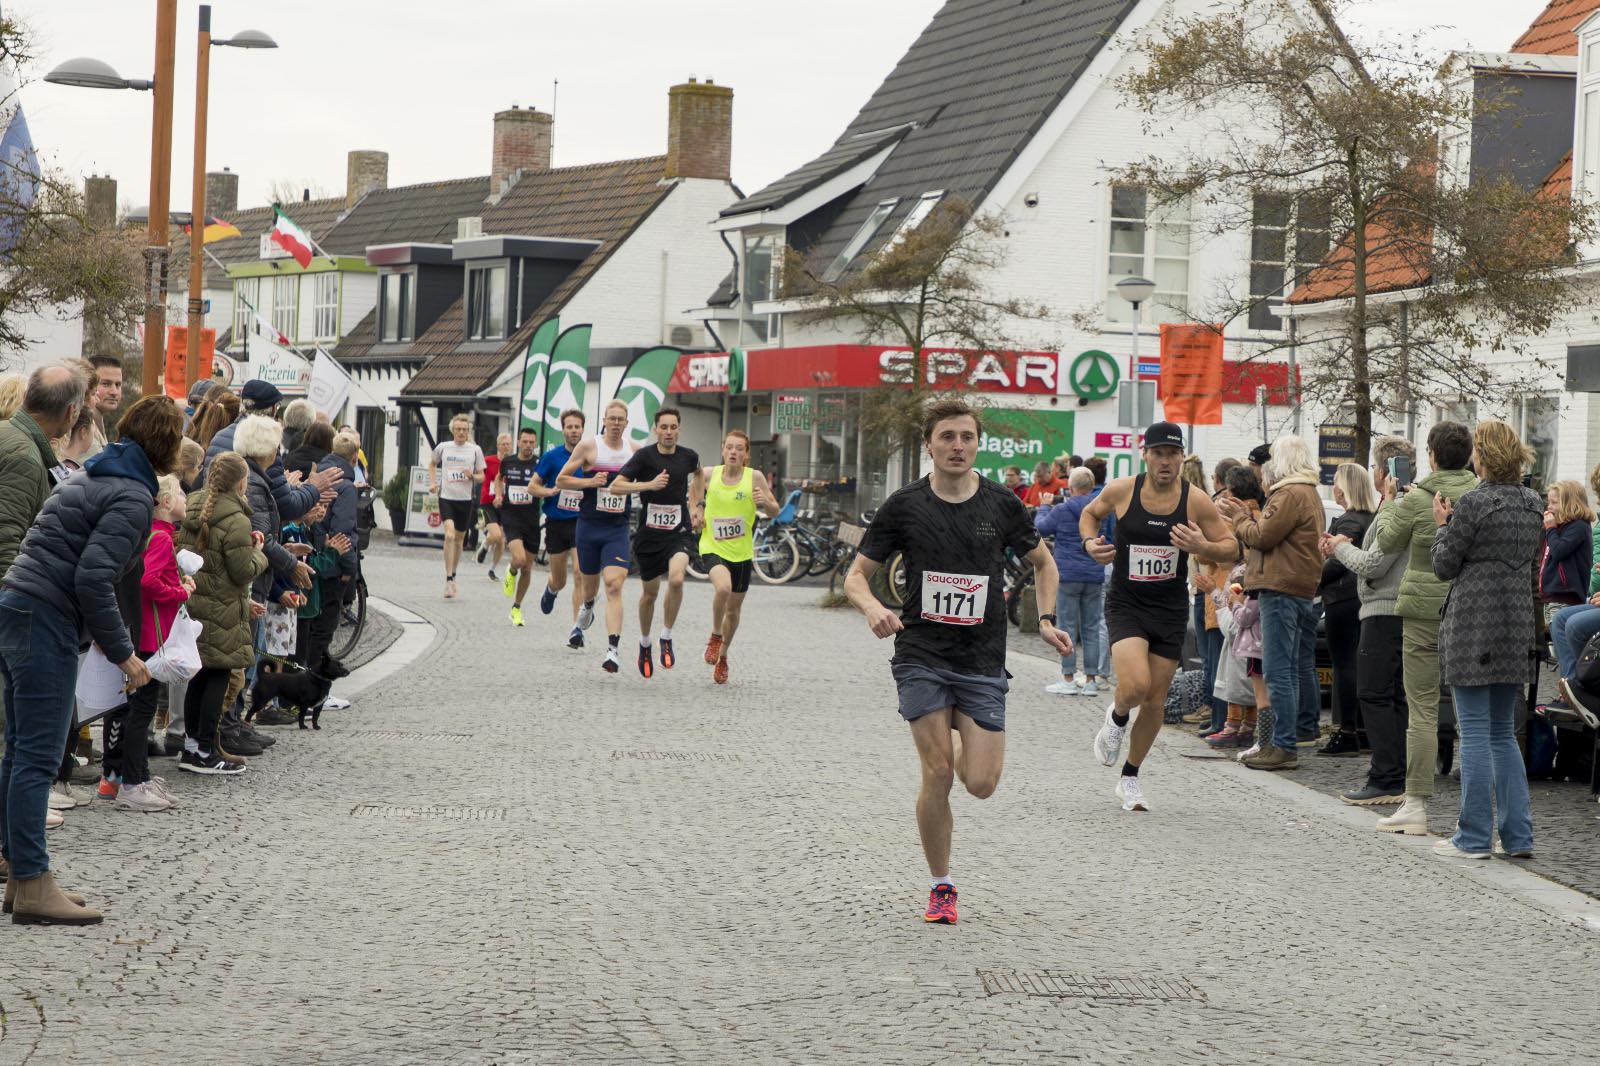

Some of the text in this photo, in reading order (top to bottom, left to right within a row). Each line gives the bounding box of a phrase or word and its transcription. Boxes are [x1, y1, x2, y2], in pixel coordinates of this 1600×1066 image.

[258, 364, 297, 381] Pizzeria
[689, 356, 729, 389] SPAR
[879, 350, 1056, 389] SPAR
[512, 493, 529, 501] 1134
[602, 497, 623, 508] 1187
[653, 513, 676, 525] 1132
[718, 525, 741, 537] 1130
[1133, 546, 1168, 555] saucony
[1137, 559, 1171, 576] 1103
[927, 573, 973, 587] saucony
[932, 591, 976, 617] 1171
